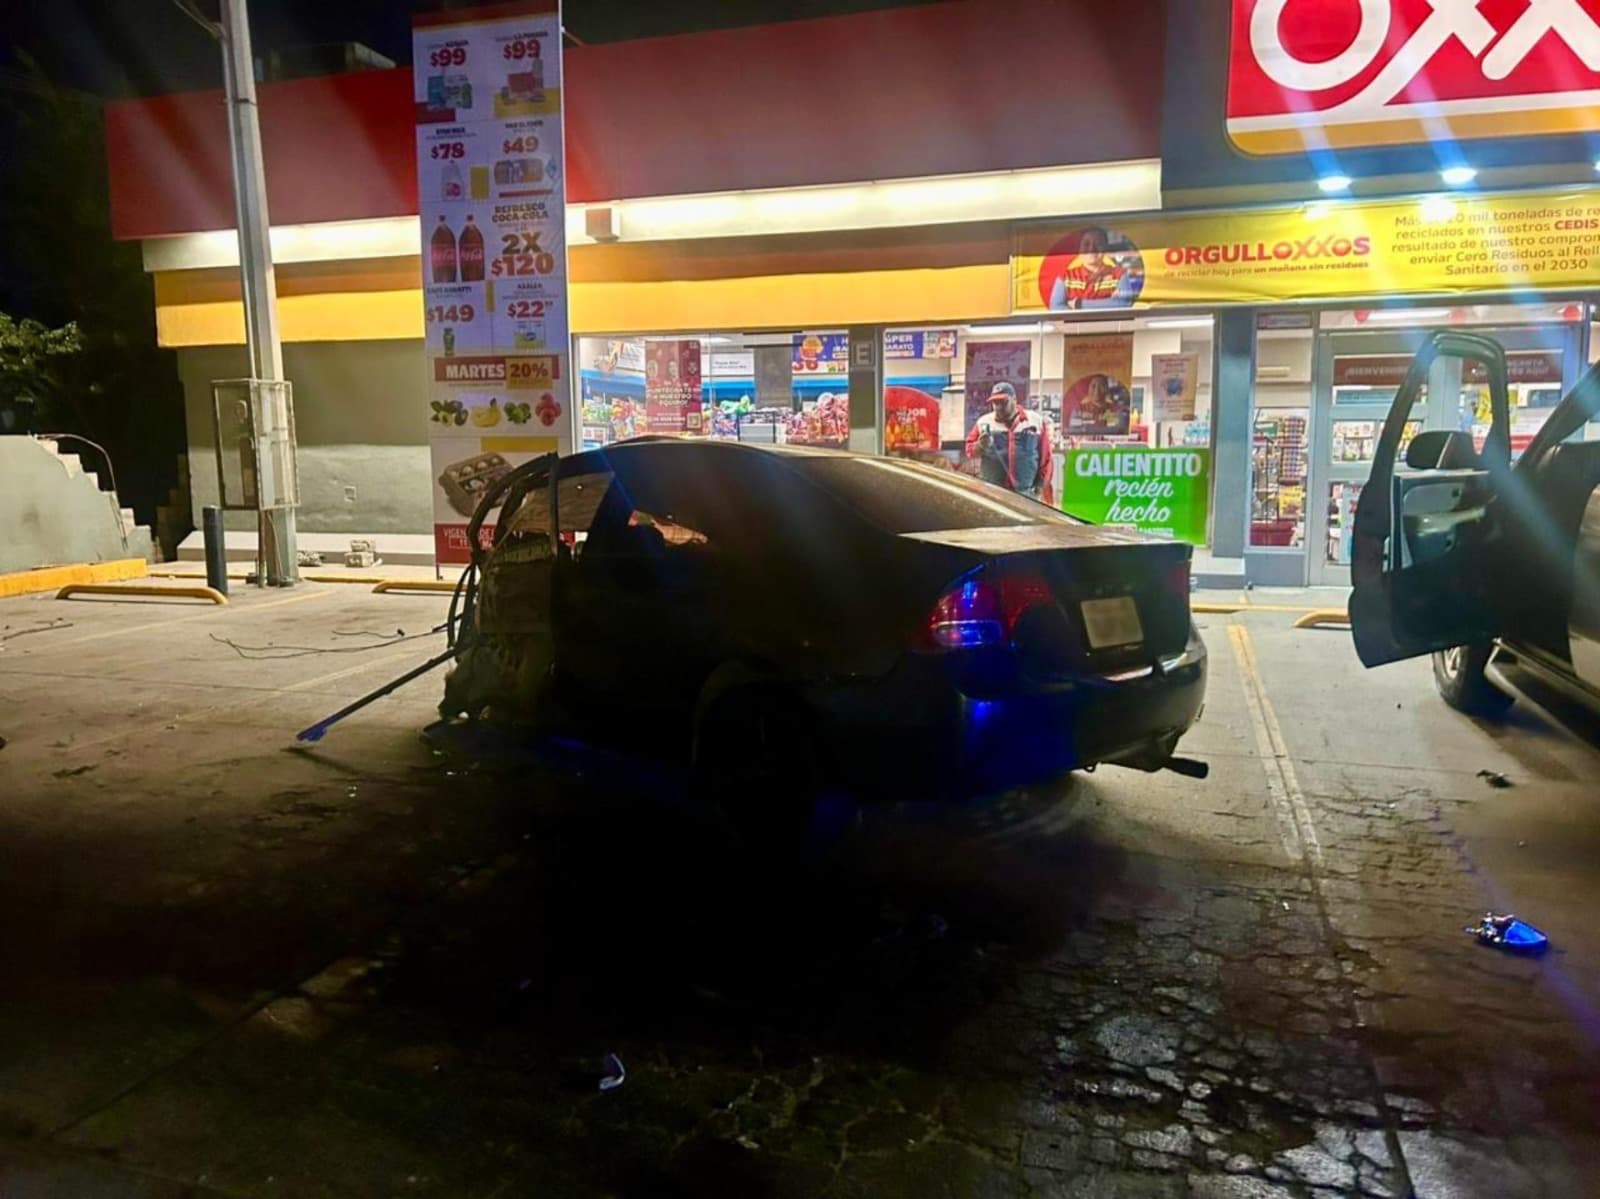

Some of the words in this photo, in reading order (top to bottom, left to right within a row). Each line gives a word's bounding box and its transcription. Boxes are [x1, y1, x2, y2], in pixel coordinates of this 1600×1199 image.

[430, 47, 467, 68] $99
[503, 39, 541, 60] $99
[431, 142, 465, 160] $78
[503, 135, 540, 154] $49
[1468, 211, 1489, 222] mil
[1493, 206, 1562, 221] toneladas
[1565, 204, 1584, 217] de
[1395, 228, 1464, 240] reciclados
[1467, 227, 1485, 236] en
[1488, 222, 1551, 235] nuestros
[1554, 218, 1599, 231] CEDIS
[501, 231, 543, 255] 2X
[1164, 233, 1371, 266] ORGULLOXXOS
[1391, 241, 1456, 253] resultado
[1459, 239, 1477, 249] de
[1480, 236, 1535, 249] nuestro
[490, 252, 555, 276] $120
[1409, 252, 1453, 265] enviar
[1456, 250, 1488, 262] Cero
[1491, 248, 1554, 261] Residuos
[1557, 246, 1570, 257] al
[1177, 267, 1211, 278] reciclar
[1212, 267, 1230, 278] hoy
[1268, 262, 1307, 273] mañana
[1308, 261, 1324, 271] sin
[1325, 259, 1370, 271] residuos
[1445, 263, 1508, 276] Sanitario
[1511, 262, 1529, 272] en
[1533, 260, 1546, 271] el
[1549, 258, 1588, 271] 2030
[427, 303, 475, 322] $149
[445, 363, 505, 379] MARTES
[509, 362, 548, 378] 20%
[1075, 452, 1201, 477] CALIENTITO
[1104, 477, 1174, 497] recién
[1105, 498, 1171, 522] hecho
